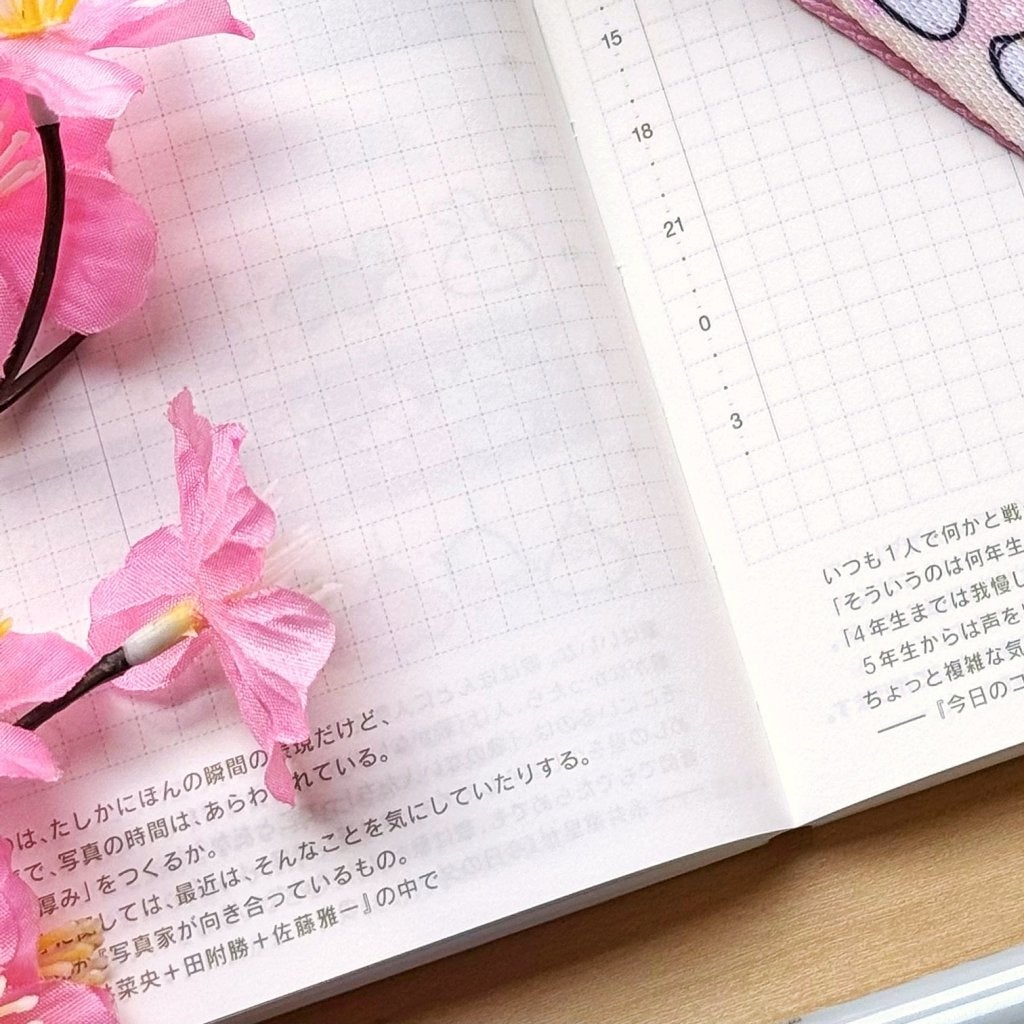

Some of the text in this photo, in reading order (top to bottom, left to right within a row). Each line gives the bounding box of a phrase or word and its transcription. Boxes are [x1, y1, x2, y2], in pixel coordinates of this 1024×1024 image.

[601, 29, 623, 50] 15
[631, 122, 654, 143] 18
[663, 216, 685, 238] 21
[699, 314, 711, 332] 0
[729, 412, 743, 430] 3
